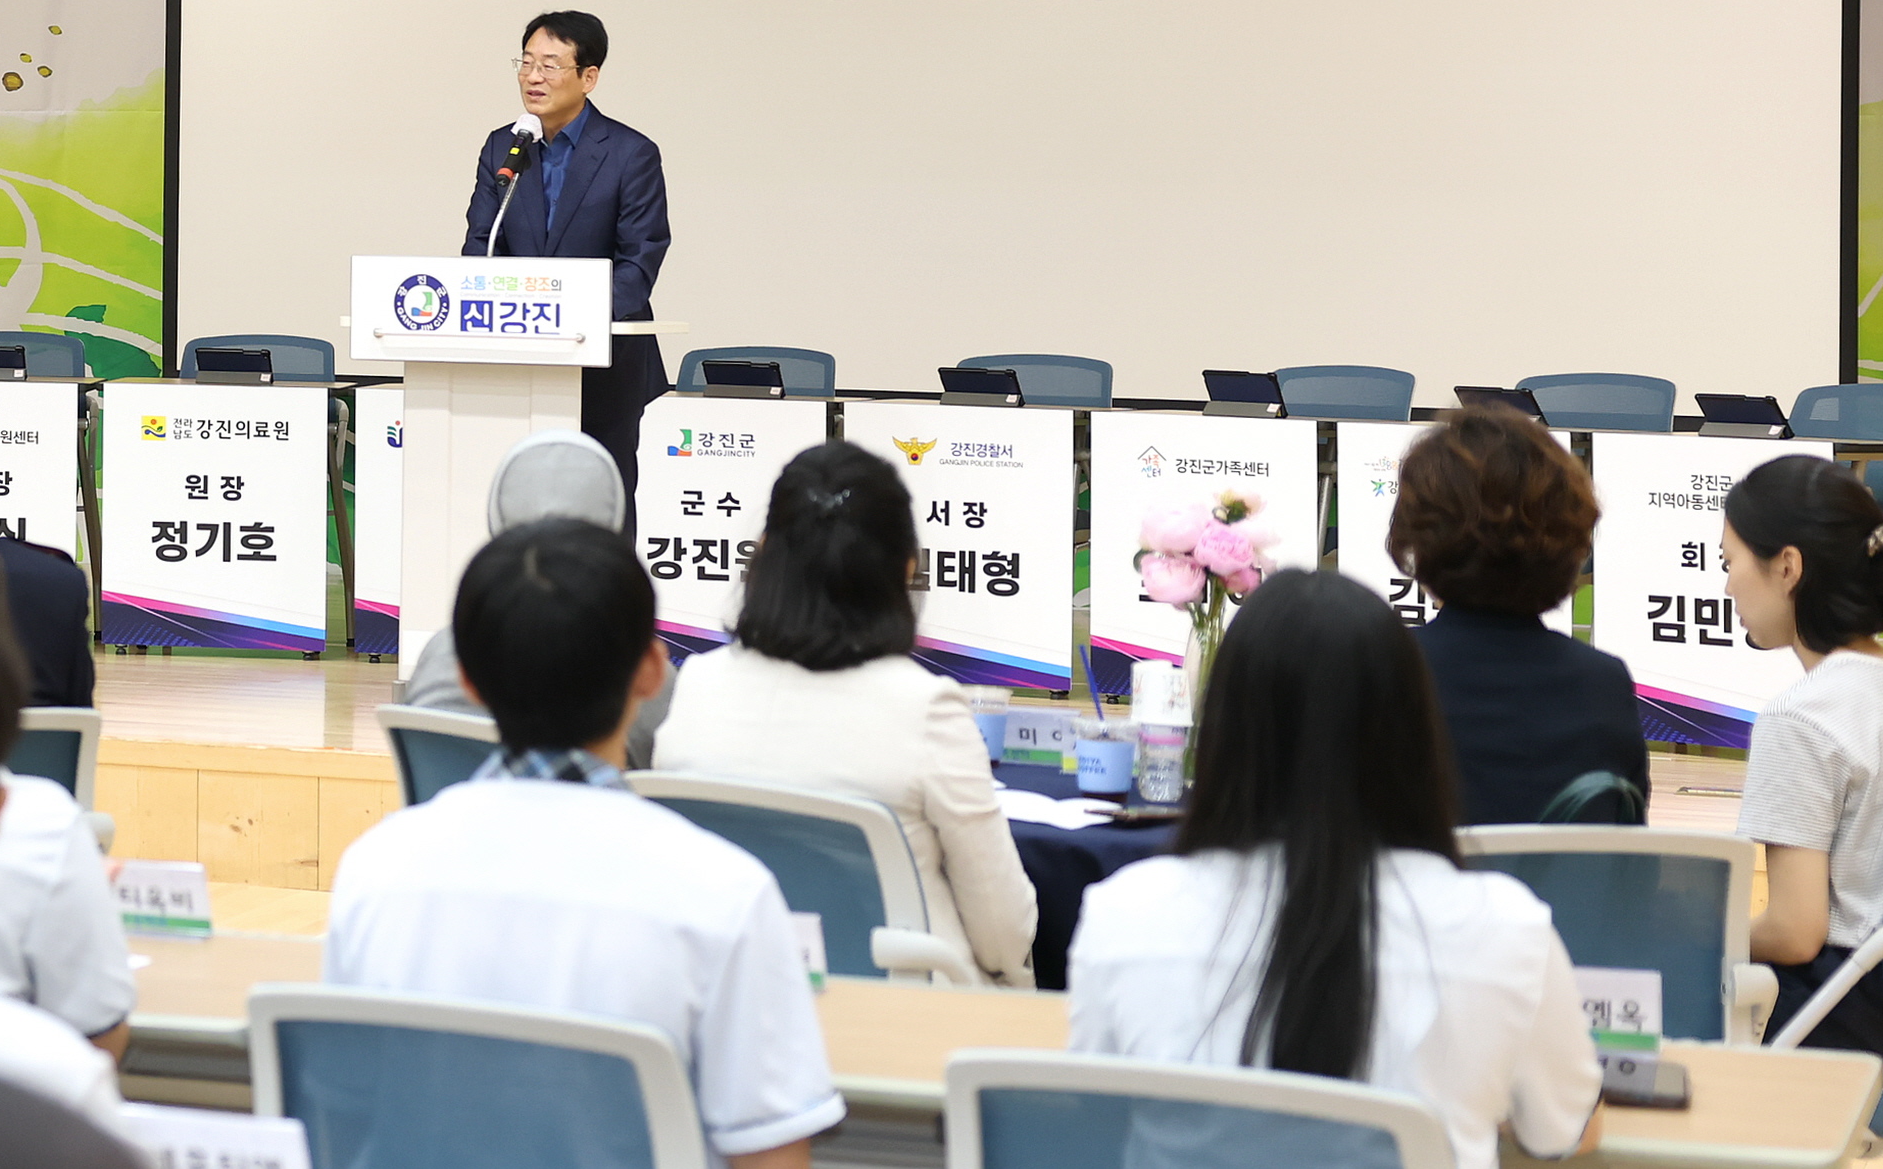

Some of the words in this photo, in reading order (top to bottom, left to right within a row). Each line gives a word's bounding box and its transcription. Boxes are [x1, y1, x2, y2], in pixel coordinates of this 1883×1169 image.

[397, 307, 418, 330] GANG
[433, 307, 449, 330] CITY
[173, 418, 193, 429] 전라
[196, 419, 289, 441] 강진의료원
[173, 429, 193, 440] 남도
[698, 432, 755, 449] 강진군
[697, 448, 756, 458] GANGJINCITY
[950, 442, 1013, 459] 강진경찰서
[939, 458, 969, 466] GANGJIN
[970, 459, 994, 467] POLICE
[996, 460, 1024, 468] STATION
[1175, 458, 1269, 478] 강진군가족센터
[1690, 474, 1734, 492] 강진군
[151, 520, 278, 563] 정기호
